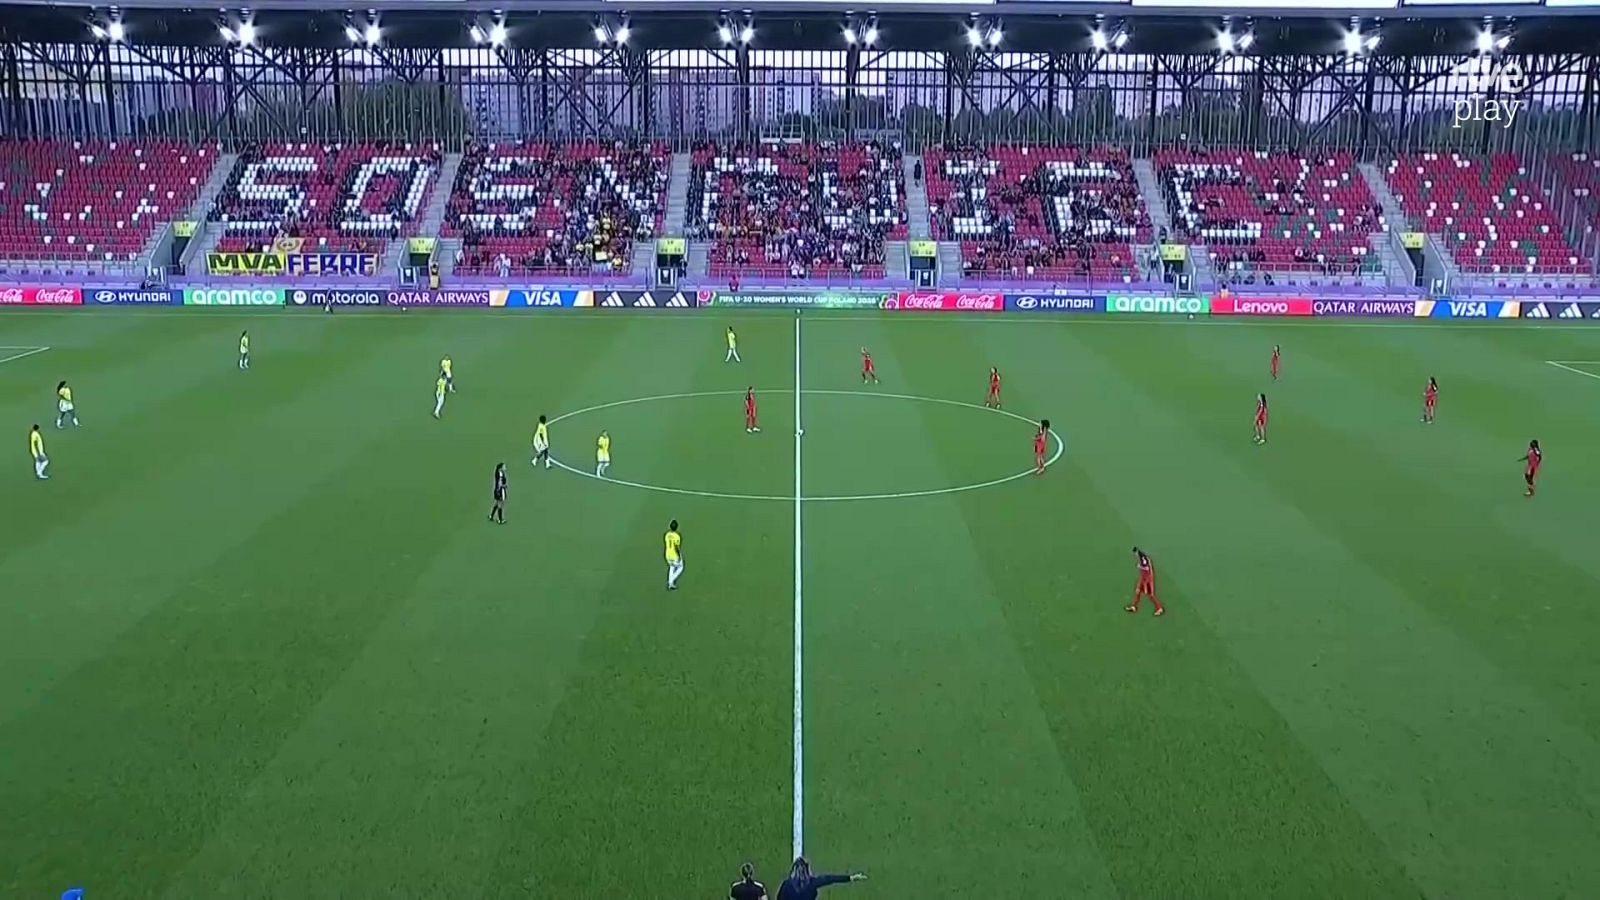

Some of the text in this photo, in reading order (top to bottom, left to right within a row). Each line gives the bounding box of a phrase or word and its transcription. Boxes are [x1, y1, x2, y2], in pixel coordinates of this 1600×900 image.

[208, 254, 282, 269] MVA
[118, 292, 171, 302] HYUNDAI
[192, 290, 276, 305] aramco
[312, 290, 379, 304] motorola
[387, 292, 489, 304] QATAR AIRWAYS
[521, 291, 562, 305] VISA
[1041, 298, 1094, 309] HYUNDAI
[1115, 297, 1201, 312] aramco
[1234, 299, 1288, 313] Lenovo
[1313, 302, 1414, 314] QATAR AIRWAYS
[1449, 302, 1488, 316] VISA
